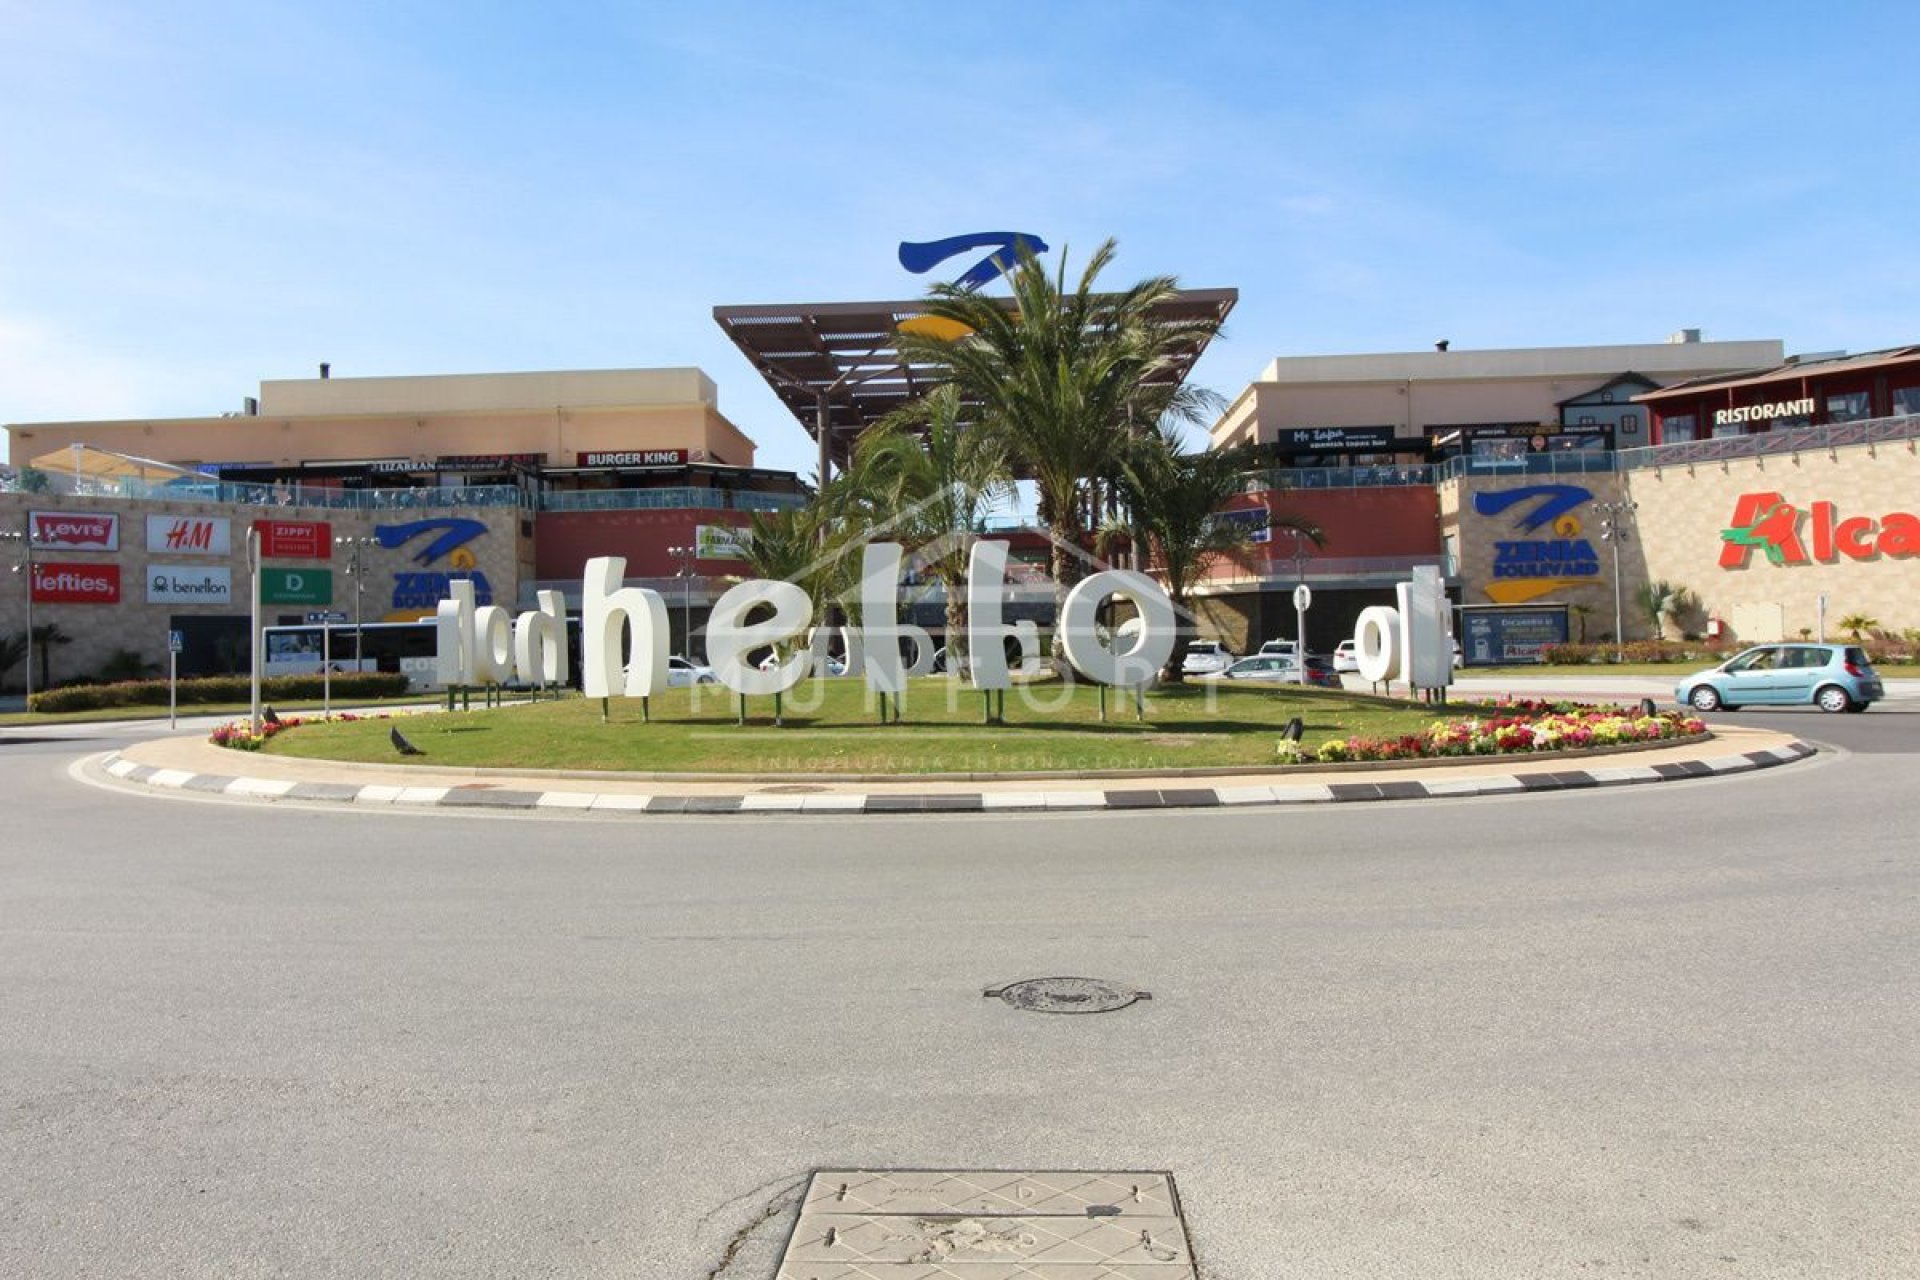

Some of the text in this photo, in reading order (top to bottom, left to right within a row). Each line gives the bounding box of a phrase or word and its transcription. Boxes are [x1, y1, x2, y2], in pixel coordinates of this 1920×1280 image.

[1716, 398, 1815, 425] RISTORANTI
[587, 451, 679, 465] BURGER KING
[166, 520, 214, 550] H&M
[276, 527, 312, 537] ZIPPY
[1495, 540, 1598, 562] ZENIA
[1494, 562, 1599, 577] BOULEVARD
[173, 577, 226, 594] benetton
